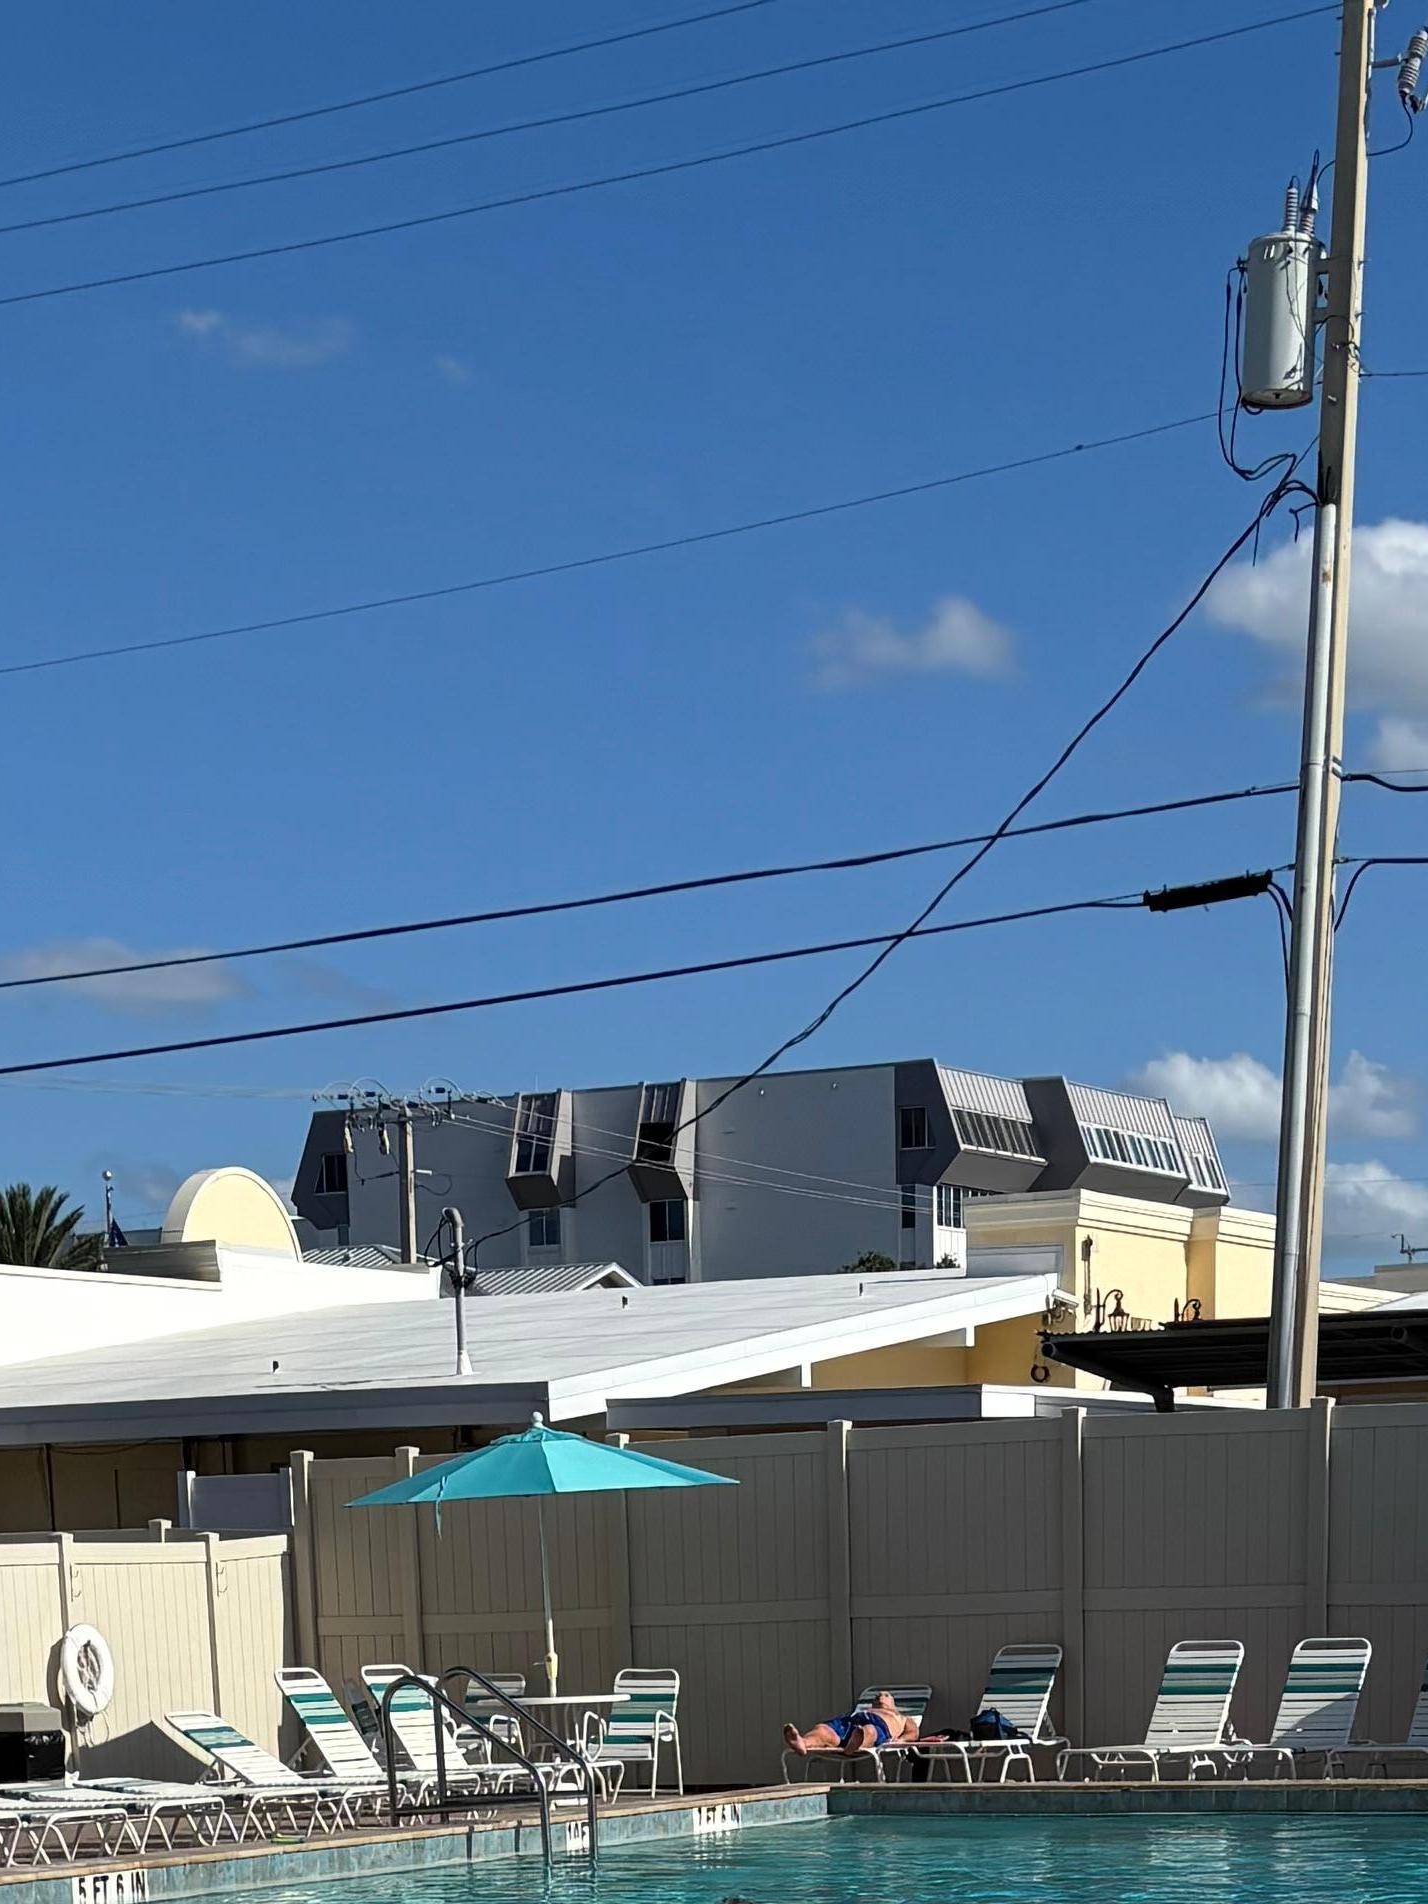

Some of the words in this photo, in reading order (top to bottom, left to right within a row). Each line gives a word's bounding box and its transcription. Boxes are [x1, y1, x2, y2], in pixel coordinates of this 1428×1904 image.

[78, 1877, 86, 1901] 5
[93, 1875, 109, 1904] FT
[116, 1873, 124, 1900] 6
[131, 1870, 146, 1900] IN
